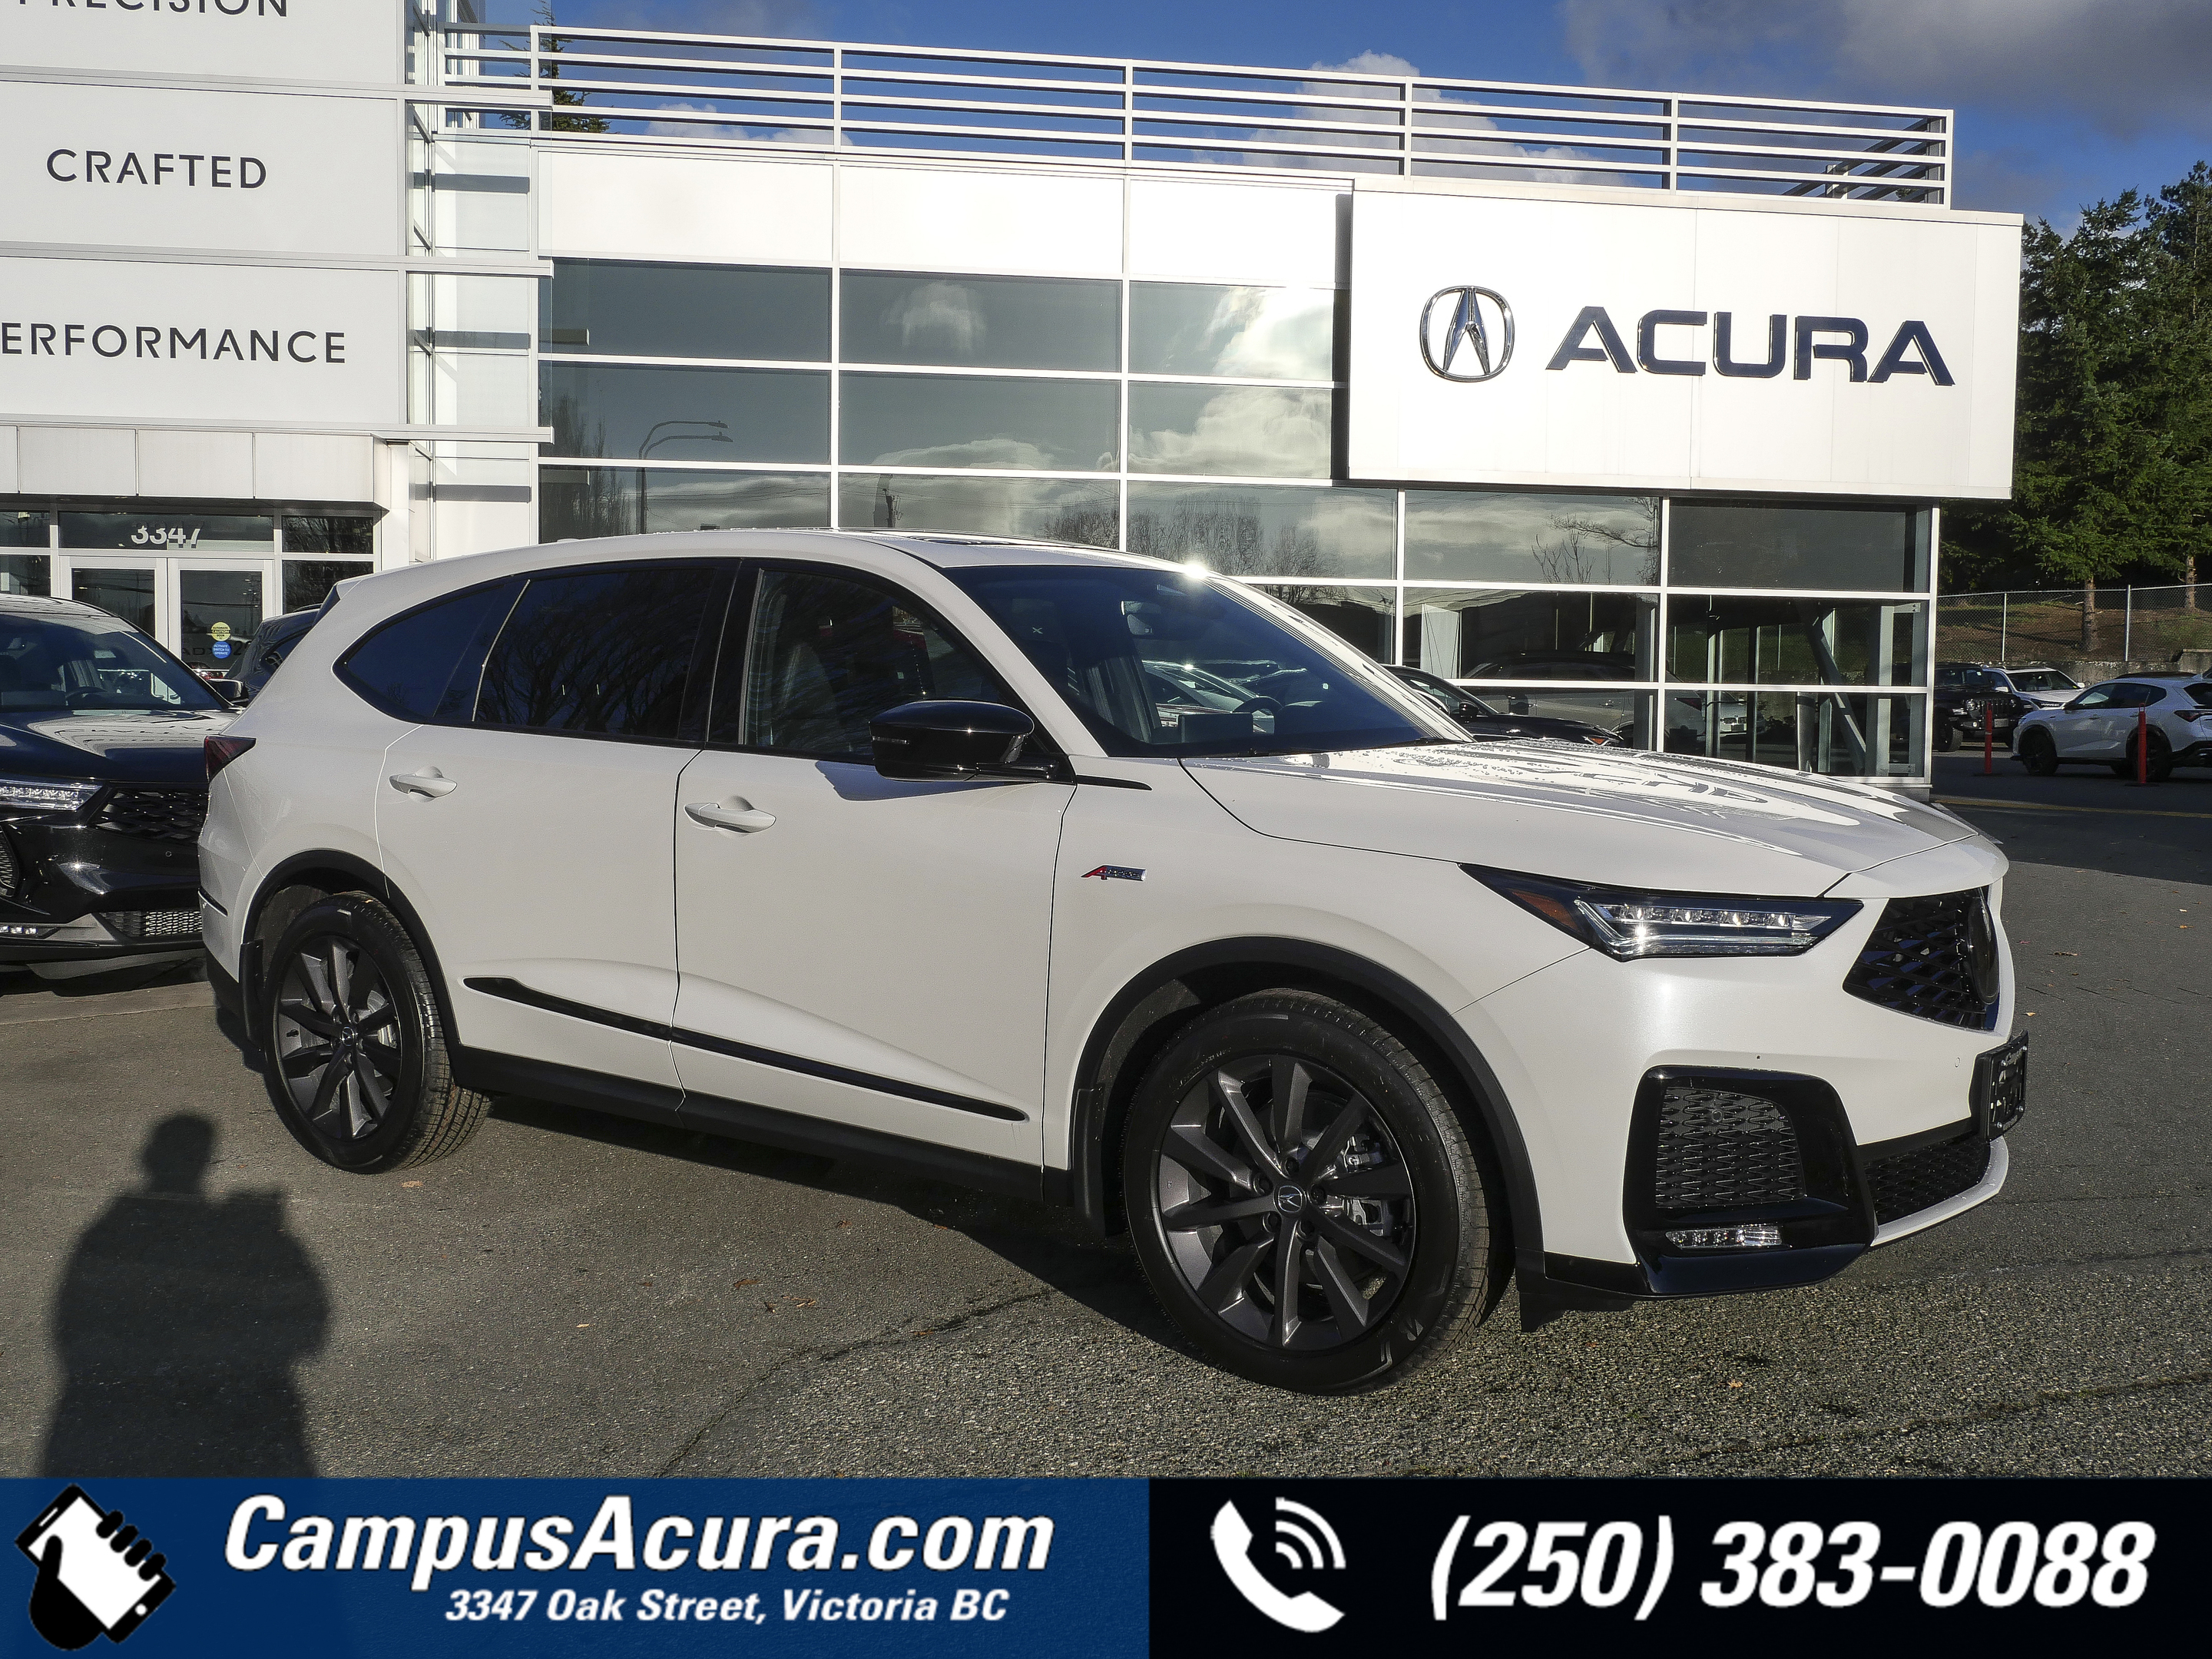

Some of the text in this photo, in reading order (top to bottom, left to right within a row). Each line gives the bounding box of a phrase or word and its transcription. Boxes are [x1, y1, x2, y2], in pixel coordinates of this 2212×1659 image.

[46, 148, 267, 190] CRAFTED
[1545, 306, 1956, 386] ACURA
[131, 521, 203, 545] 3347
